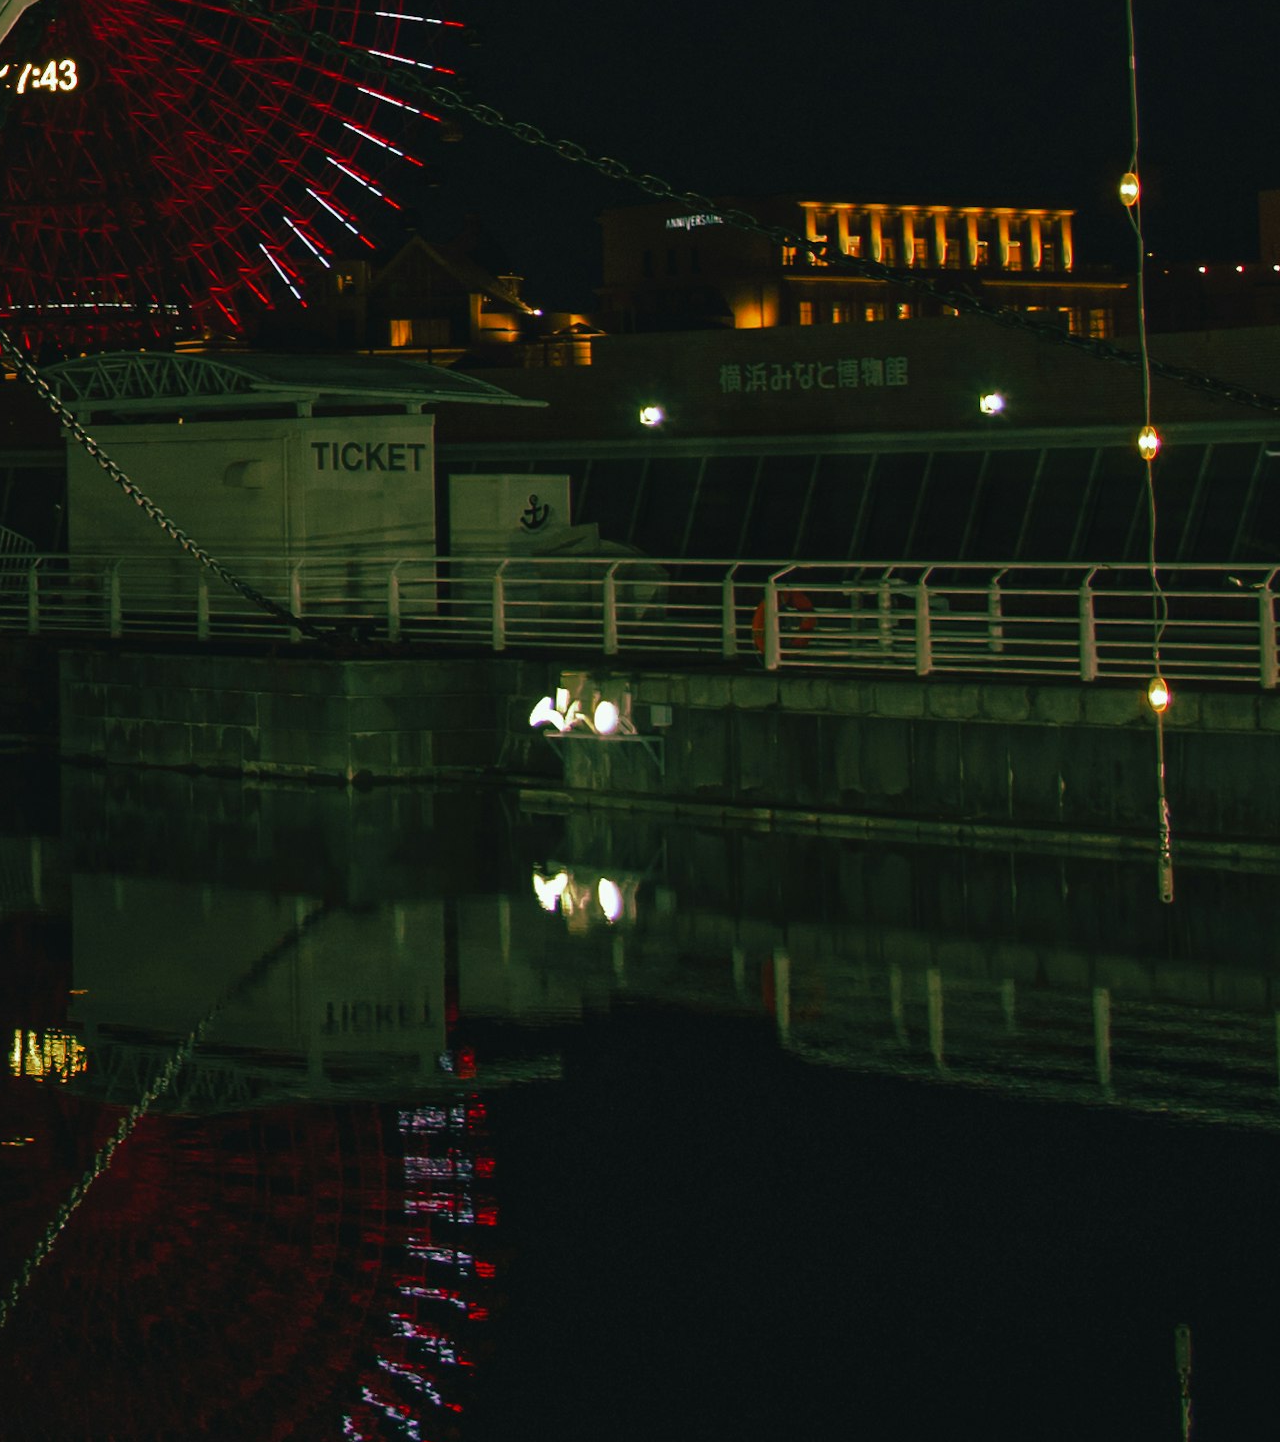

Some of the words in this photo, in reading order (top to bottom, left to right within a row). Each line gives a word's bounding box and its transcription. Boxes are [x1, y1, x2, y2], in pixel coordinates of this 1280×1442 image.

[719, 356, 909, 394] 横浜みなと博物館
[310, 441, 426, 472] TICKET
